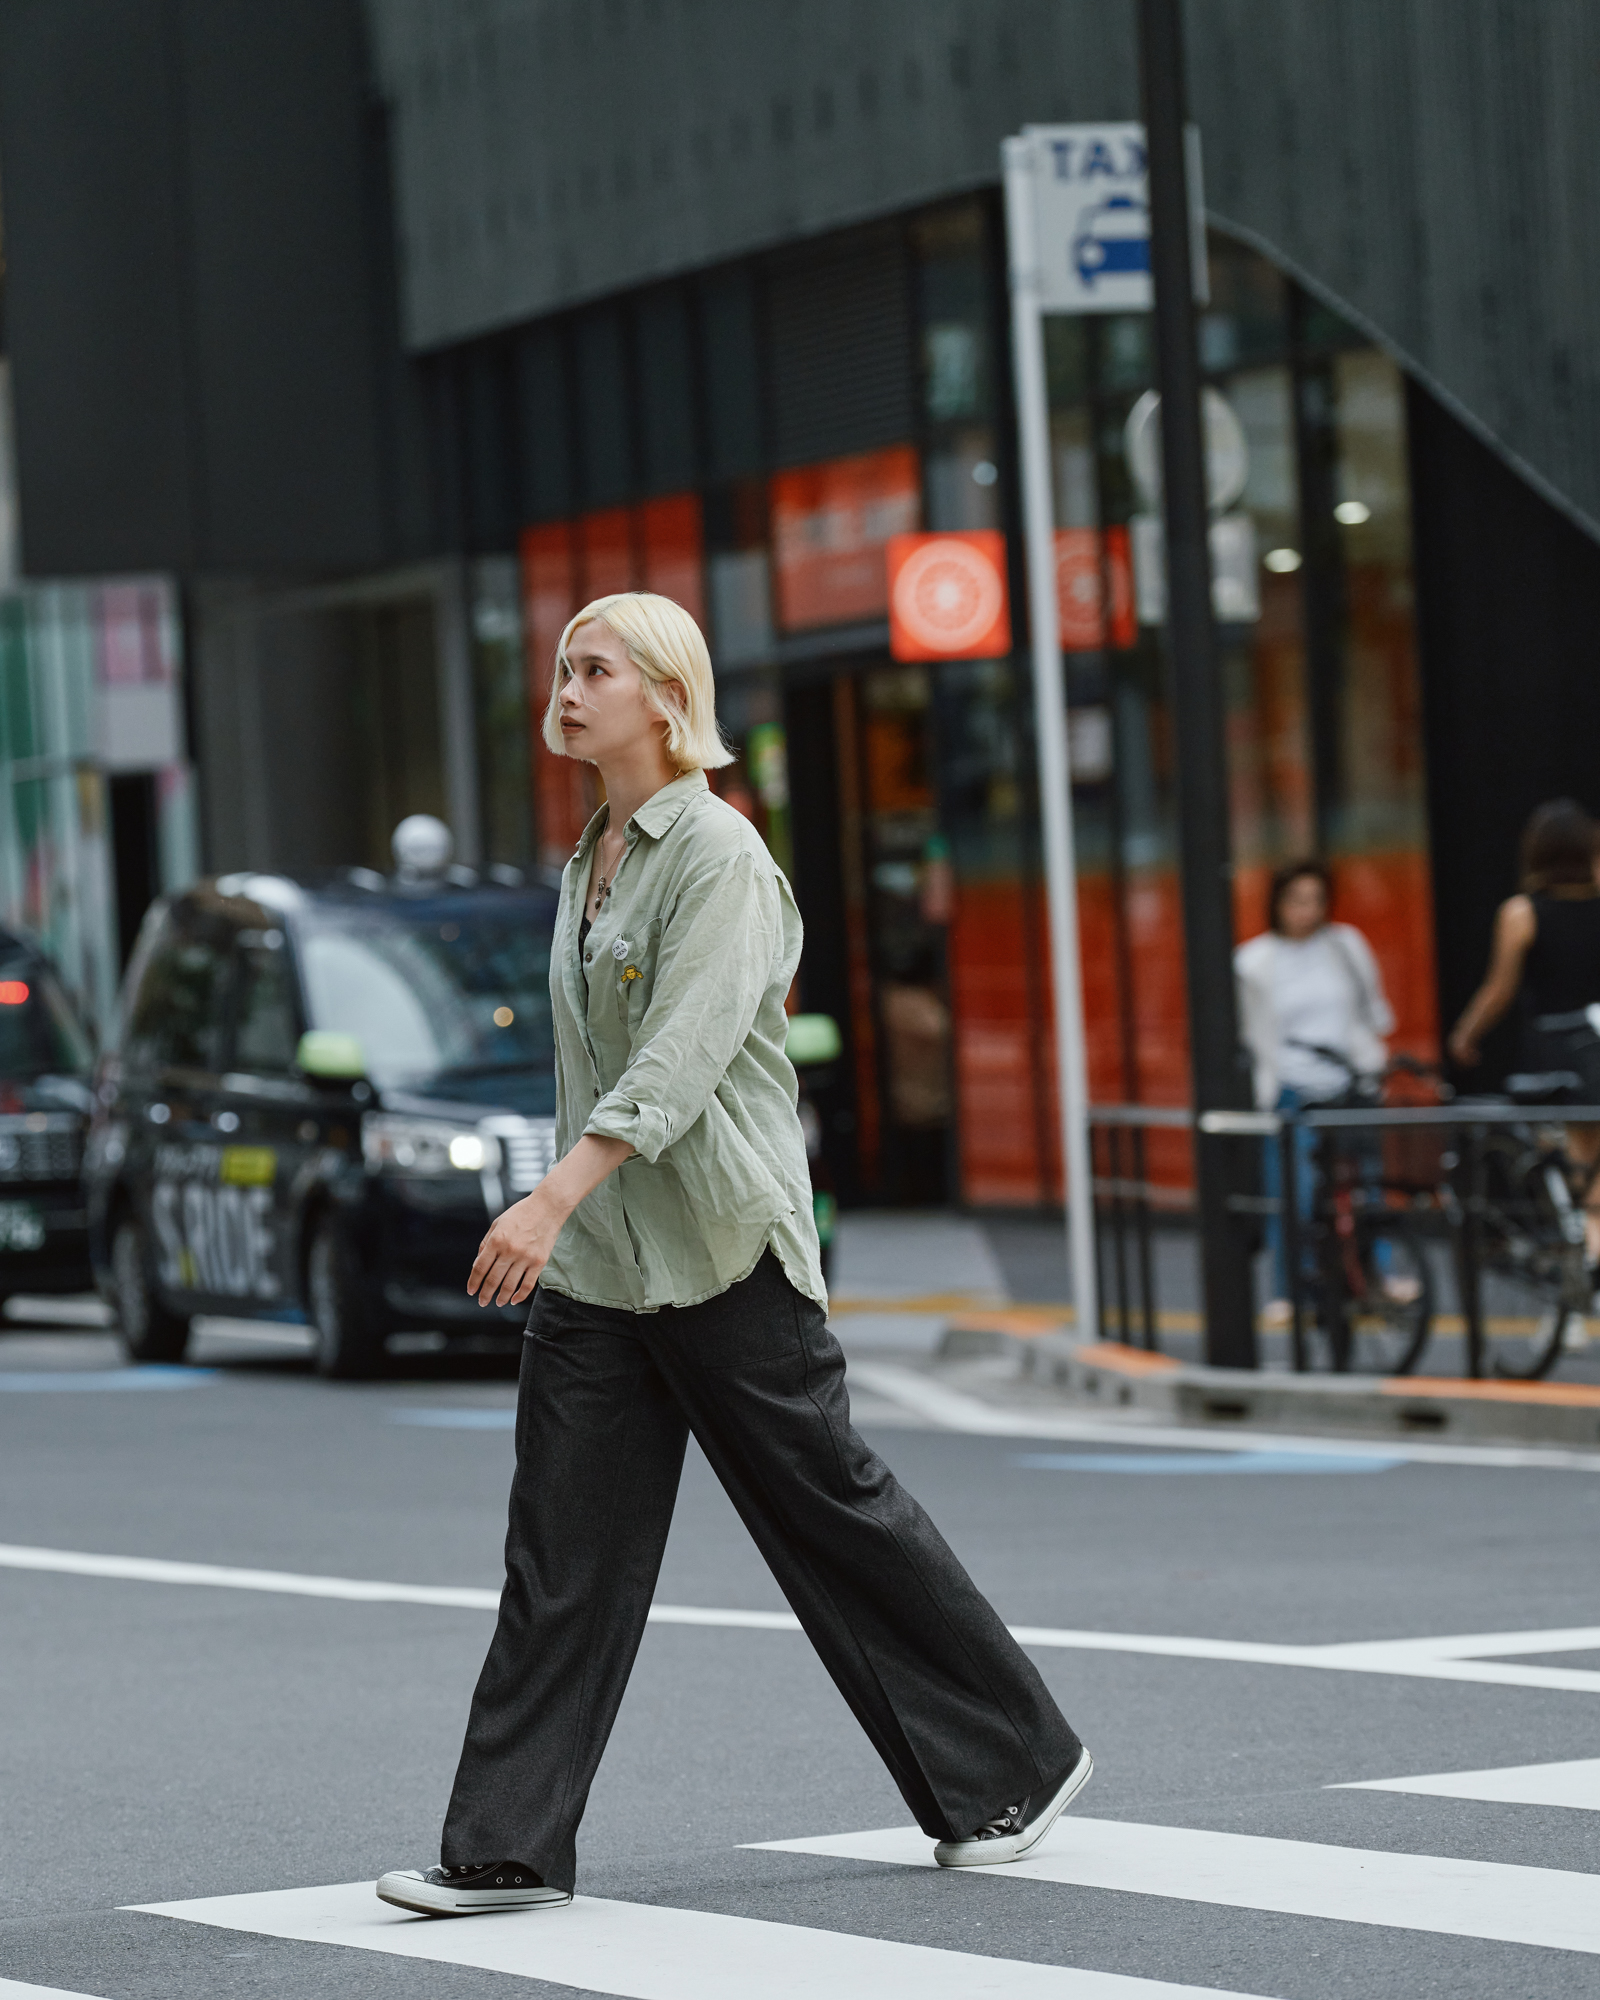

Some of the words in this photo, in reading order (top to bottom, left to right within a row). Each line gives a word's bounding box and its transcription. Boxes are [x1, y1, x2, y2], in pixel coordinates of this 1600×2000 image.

[1050, 138, 1150, 181] TAX
[612, 945, 620, 953] I'M
[615, 948, 627, 958] MESS
